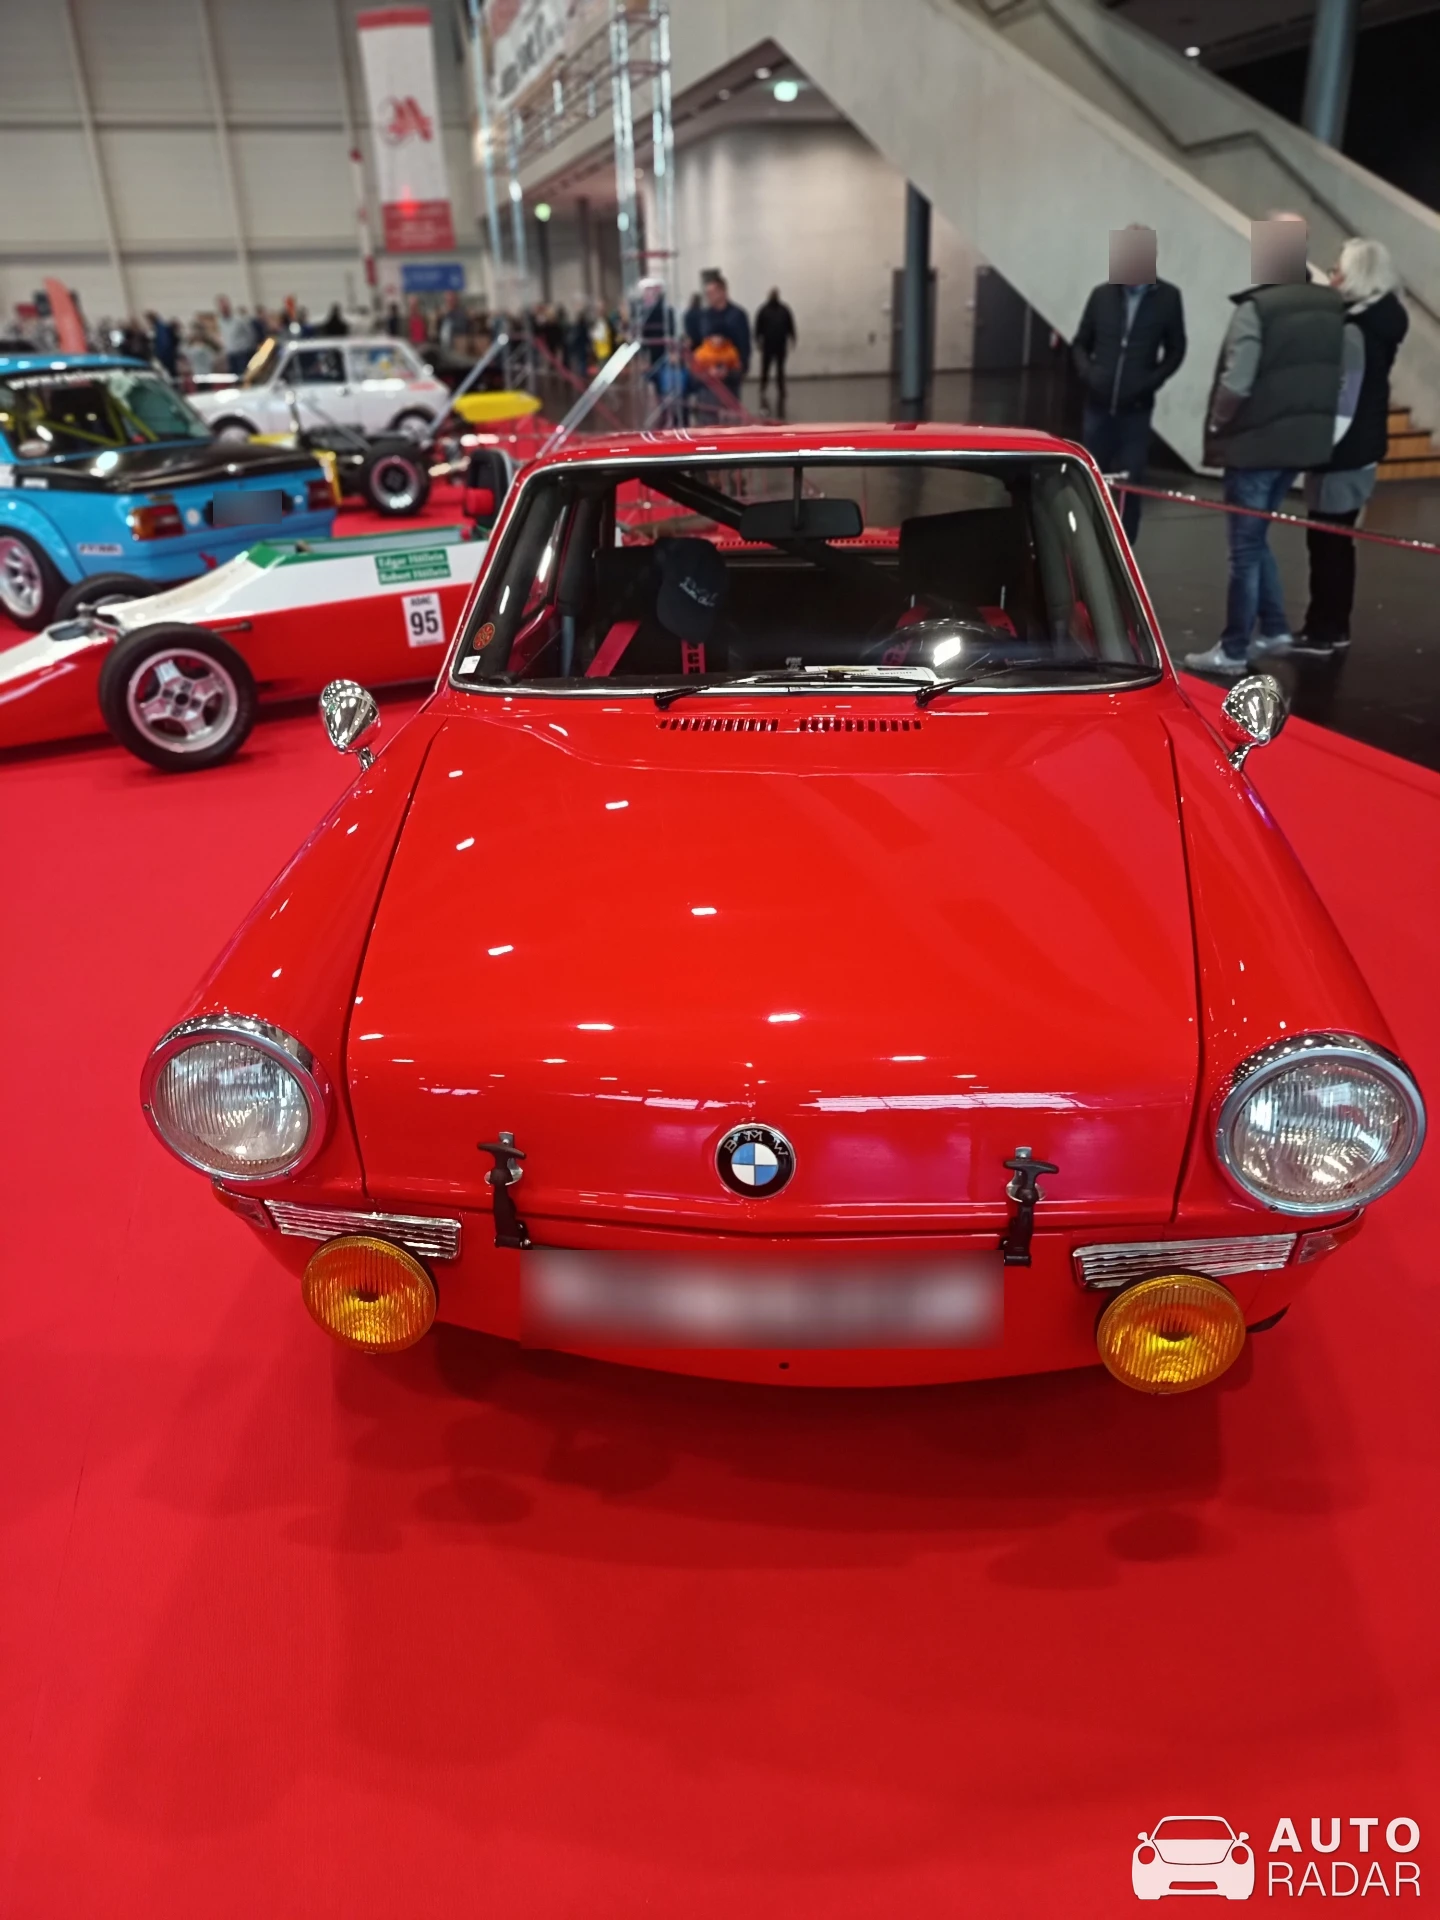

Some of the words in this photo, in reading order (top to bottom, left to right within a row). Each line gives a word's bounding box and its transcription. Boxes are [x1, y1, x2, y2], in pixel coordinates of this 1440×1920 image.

[378, 555, 406, 568] Edgar
[380, 570, 411, 583] Robert
[410, 610, 439, 636] 95
[724, 1130, 789, 1156] BMW
